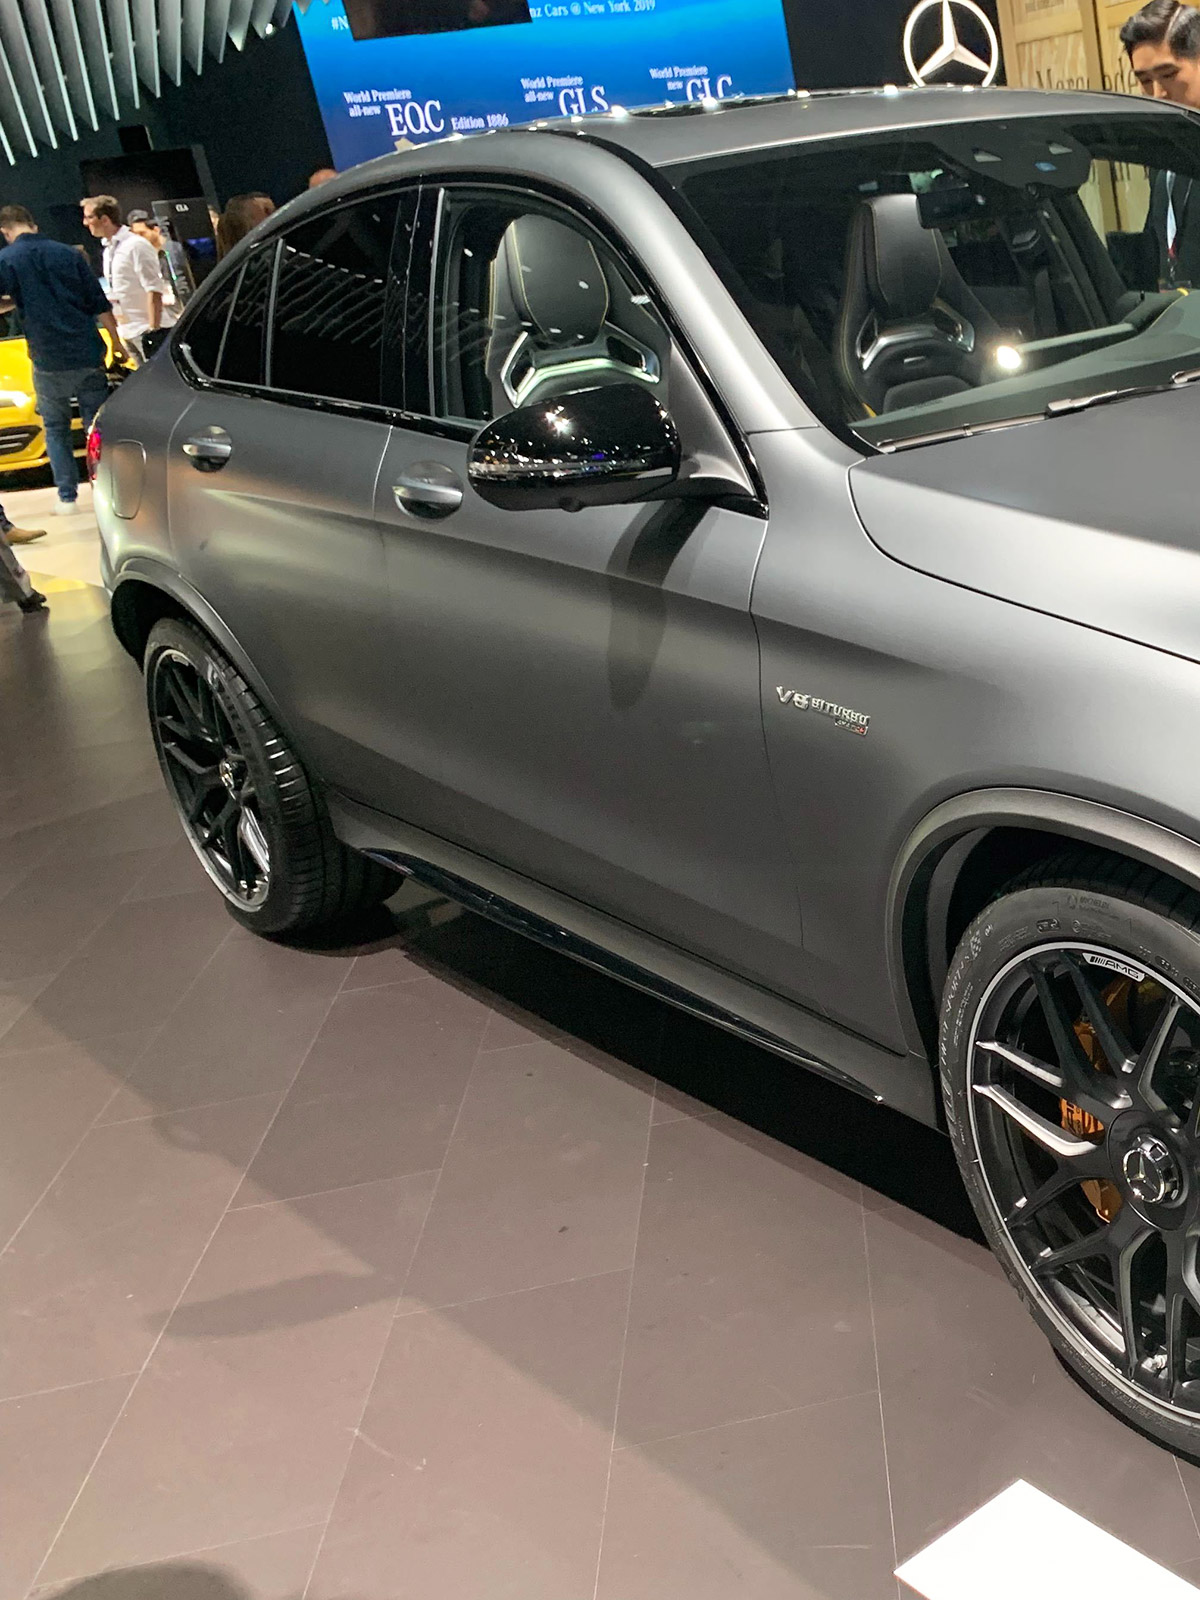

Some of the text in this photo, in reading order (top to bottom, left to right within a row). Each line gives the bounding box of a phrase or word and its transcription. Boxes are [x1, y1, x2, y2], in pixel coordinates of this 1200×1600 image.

[544, 3, 568, 17] Cars
[570, 2, 582, 16] @
[584, 1, 605, 15] New
[608, 0, 631, 13] York
[634, 0, 655, 11] 2019
[649, 64, 709, 80] World Premiere
[520, 75, 584, 90] World Premiere
[667, 80, 684, 91] new
[343, 88, 412, 105] World Premiere
[524, 91, 554, 103] all-new
[349, 100, 509, 136] all-new EQC Edition 1886
[776, 685, 872, 726] V8 BITURBO
[1103, 959, 1140, 979] AMG
